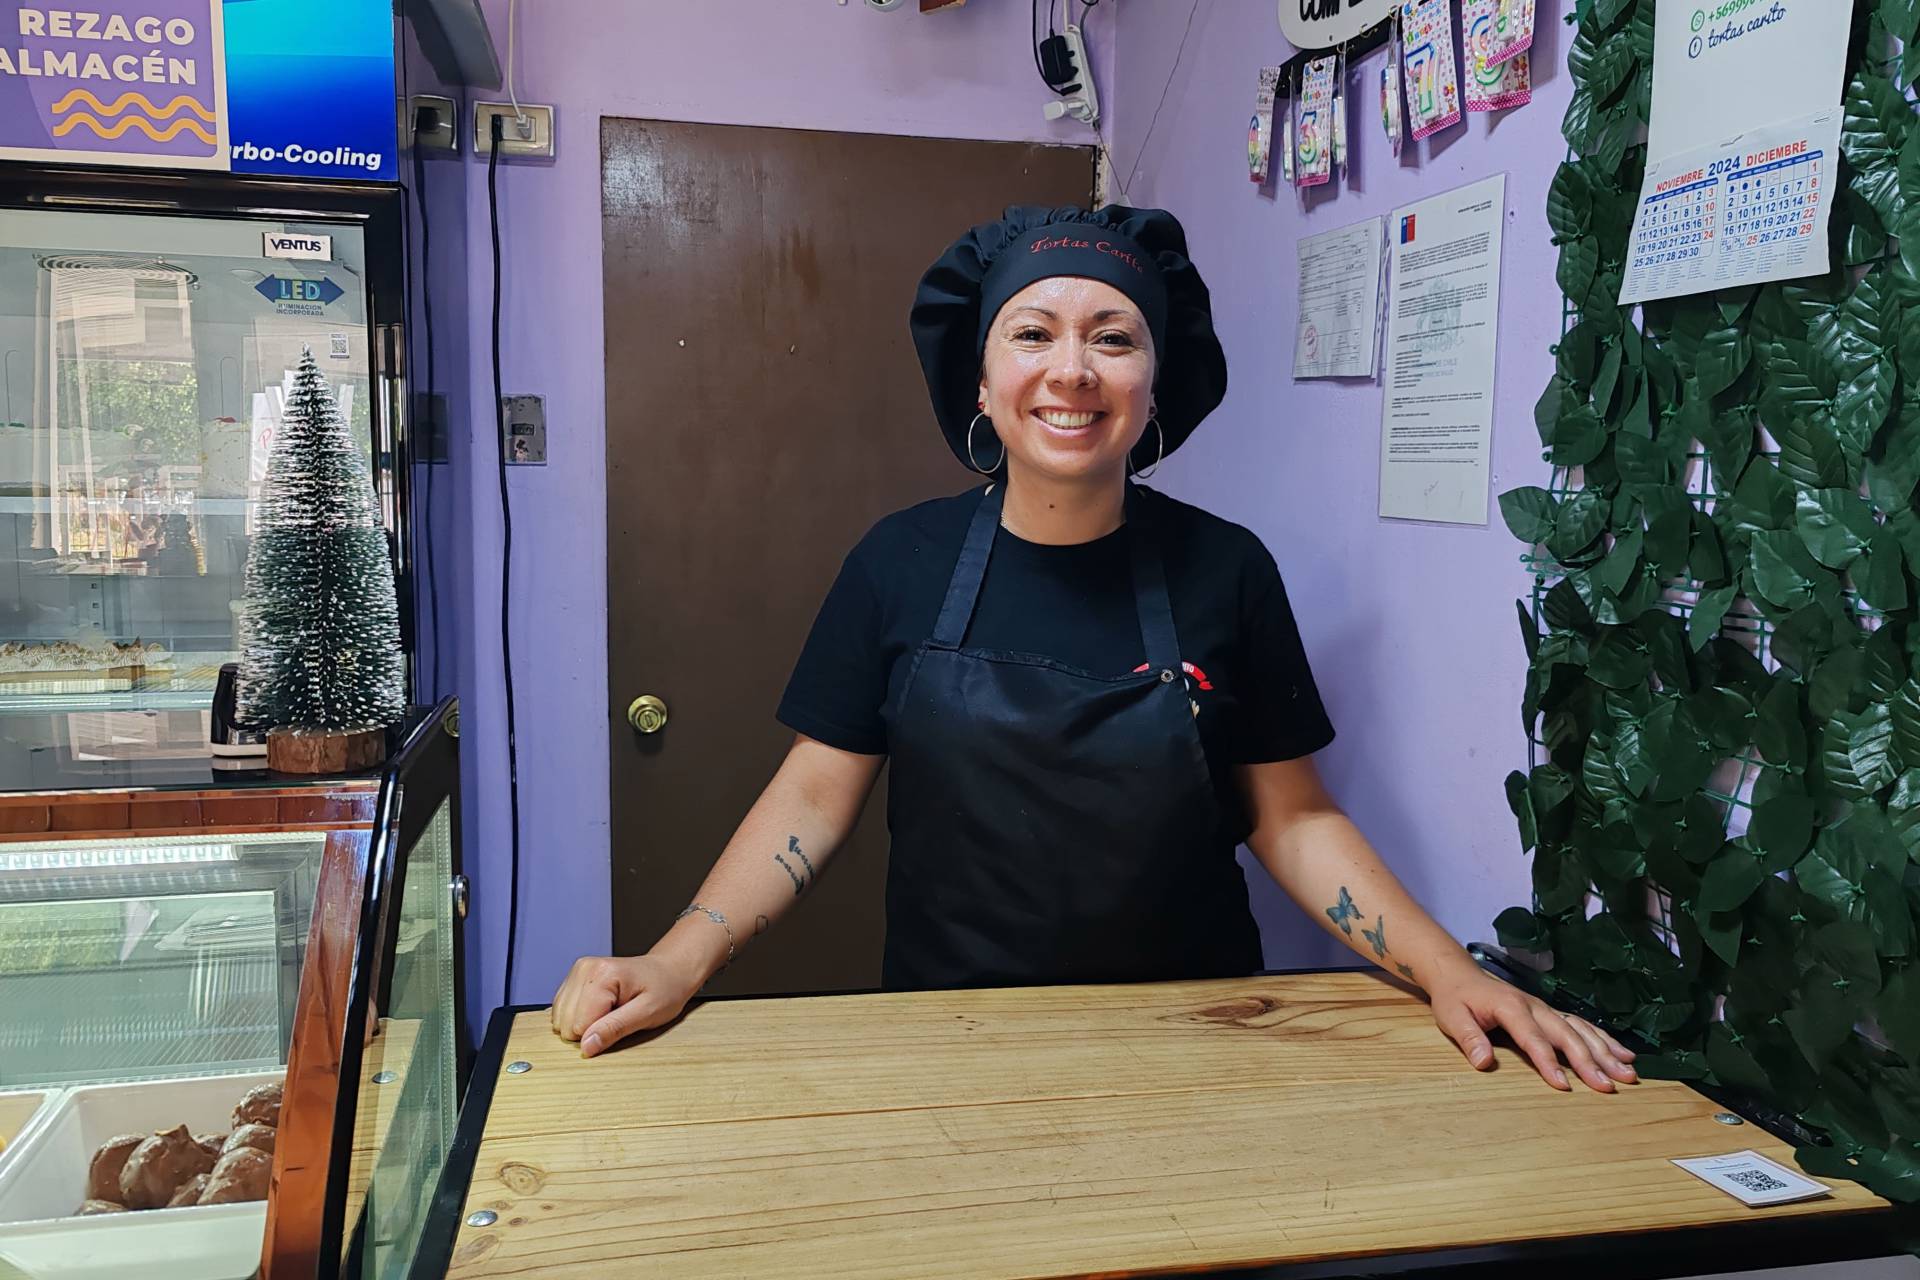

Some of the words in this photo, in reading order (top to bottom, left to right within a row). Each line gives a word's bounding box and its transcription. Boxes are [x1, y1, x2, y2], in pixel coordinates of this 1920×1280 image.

[18, 8, 195, 46] REZAGO
[1708, 21, 1745, 48] tortas
[1747, 1, 1786, 33] carito
[0, 47, 196, 85] ALMACÉN
[230, 142, 382, 171] rbo-Cooling
[1656, 169, 1704, 192] NOVIEMBRE
[1708, 155, 1741, 177] 2024
[1746, 140, 1807, 167] DICIEMBRE
[1727, 197, 1734, 207] 2
[1741, 194, 1748, 204] 3
[1754, 191, 1761, 201] 4
[1769, 187, 1775, 198] 5
[1782, 184, 1789, 194] 6
[1797, 181, 1802, 191] 7
[1810, 177, 1817, 188] 8
[1727, 211, 1733, 221] 9
[1738, 208, 1748, 219] 10
[1751, 205, 1761, 216] 11
[1765, 202, 1776, 213] 12
[1778, 199, 1789, 211] 13
[1792, 195, 1803, 207] 14
[1806, 192, 1818, 204] 15
[1639, 231, 1647, 241] 11
[1648, 229, 1658, 239] 12
[1659, 227, 1668, 237] 13
[1669, 224, 1679, 234] 14
[1680, 220, 1691, 231] 15
[1692, 218, 1702, 229] 16
[1704, 215, 1714, 226] 17
[1723, 225, 1734, 236] 16
[1737, 222, 1747, 233] 17
[1749, 219, 1760, 230] 18
[1762, 217, 1773, 228] 19
[1775, 213, 1788, 225] 20
[1789, 210, 1801, 222] 21
[1802, 207, 1815, 219] 22
[1746, 234, 1758, 246] 25
[1759, 232, 1770, 243] 26
[1772, 229, 1784, 240] 27
[1785, 226, 1798, 238] 28
[1799, 223, 1812, 235] 29
[270, 238, 322, 252] VENTUS
[1030, 236, 1089, 253] Tortas
[1637, 244, 1646, 254] 18
[1647, 241, 1656, 252] 19
[1657, 240, 1667, 250] 20
[1668, 237, 1677, 247] 21
[1679, 234, 1690, 245] 22
[1691, 232, 1701, 242] 23
[1703, 229, 1714, 240] 24
[1633, 257, 1643, 268] 25
[1644, 255, 1654, 266] 26
[1655, 253, 1665, 263] 27
[1666, 251, 1676, 261] 28
[1677, 248, 1687, 259] 29
[1688, 246, 1699, 257] 30
[280, 279, 321, 300] LED
